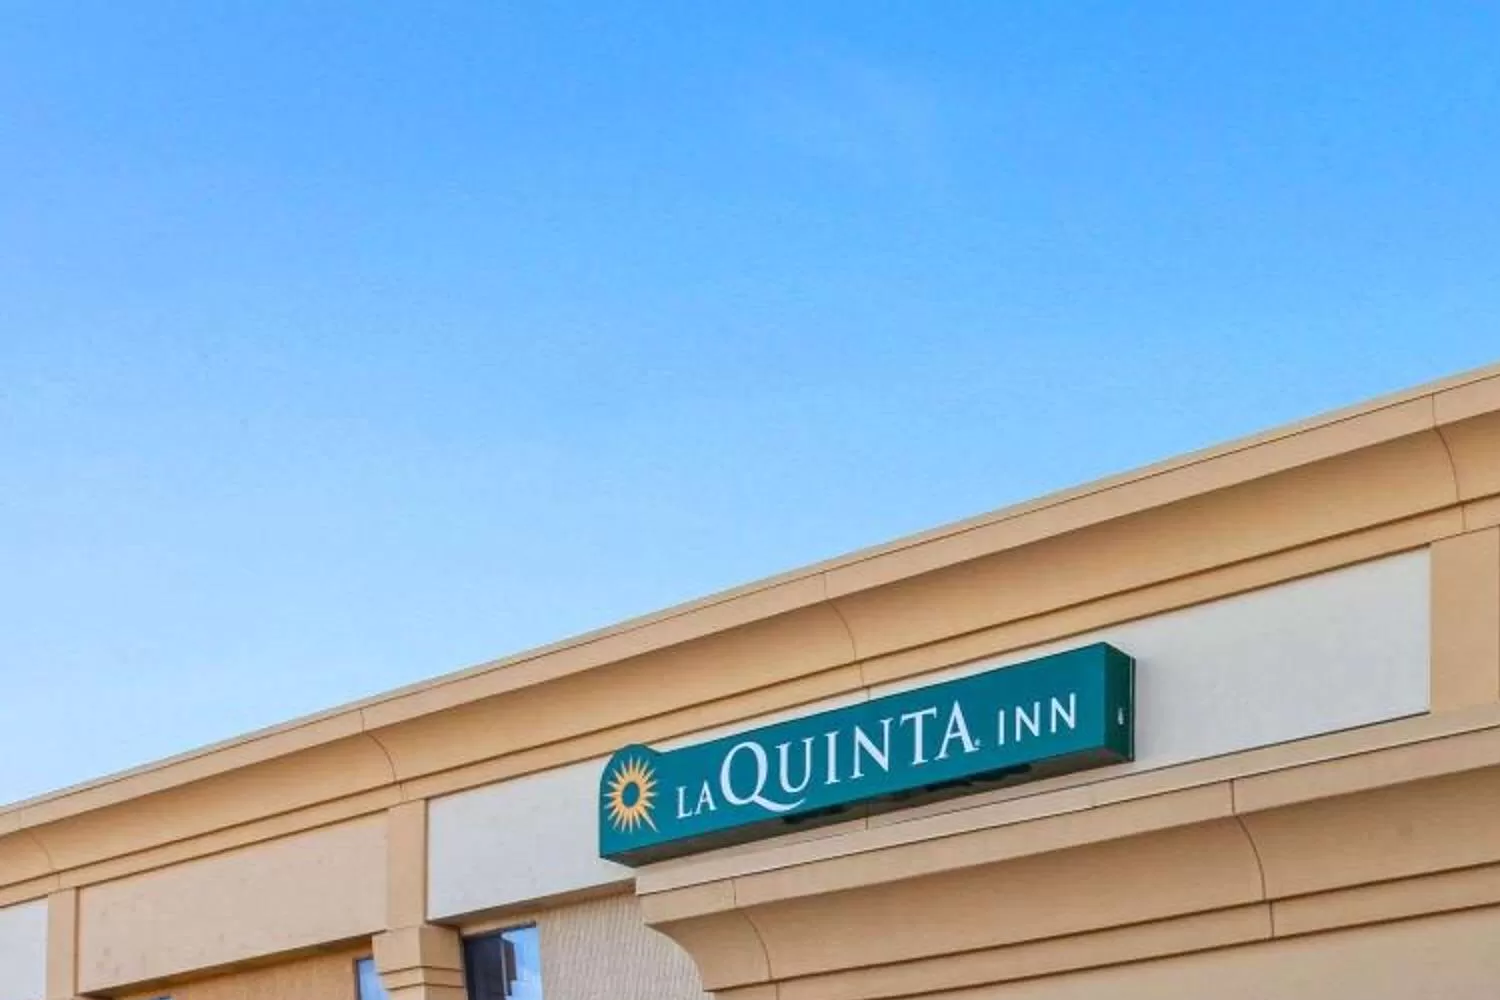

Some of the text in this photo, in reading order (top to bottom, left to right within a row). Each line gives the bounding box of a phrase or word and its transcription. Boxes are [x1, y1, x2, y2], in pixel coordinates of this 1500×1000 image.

[677, 693, 1077, 819] LA QUINTA INN
